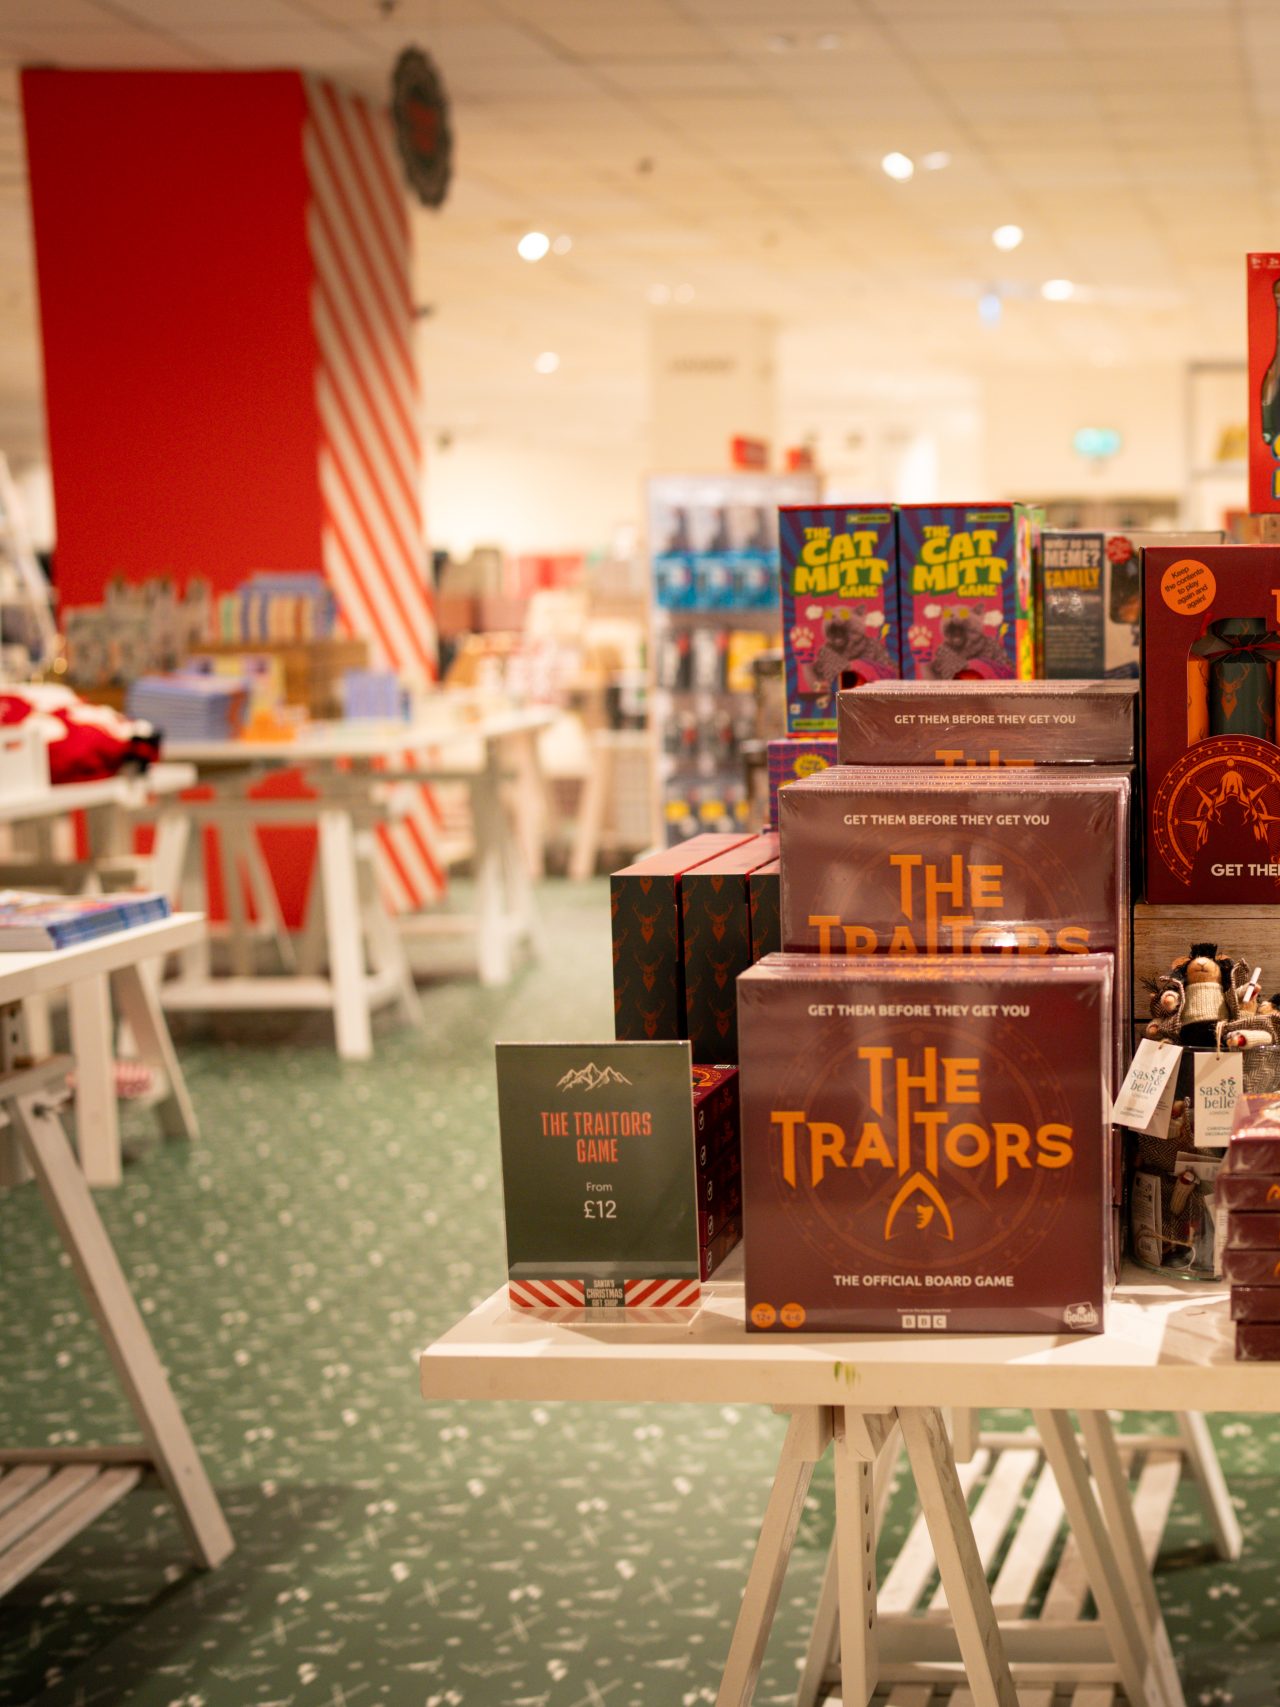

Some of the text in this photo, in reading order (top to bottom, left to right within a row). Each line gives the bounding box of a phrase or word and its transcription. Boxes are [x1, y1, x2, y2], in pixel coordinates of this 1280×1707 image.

[804, 527, 831, 540] THE
[923, 526, 950, 539] THE
[802, 530, 878, 566] CAT
[921, 529, 997, 565] CAT
[1044, 549, 1100, 568] MEME?
[794, 557, 889, 593] MITT
[913, 556, 1008, 592] MITT
[1044, 567, 1100, 591] FAMILY
[838, 585, 878, 598] GAME
[957, 584, 997, 597] GAME
[894, 715, 1076, 725] GET THEM BEFORE THEY GET YOU
[843, 814, 1050, 826] GET THEM BEFORE THEY GET YOU
[1210, 863, 1243, 877] GET
[890, 854, 1004, 920] THE
[808, 1005, 1030, 1017] GET THEM BEFORE THEY GET YOU
[857, 1046, 981, 1118] THE
[1129, 1080, 1158, 1095] belle
[1204, 1097, 1235, 1110] belle
[540, 1111, 653, 1137] THE TRAITORS
[576, 1138, 619, 1163] GAME
[770, 1110, 1075, 1190] TRAITORS
[585, 1182, 613, 1193] From
[583, 1200, 617, 1219] £12
[833, 1275, 1014, 1287] THE OFFICIAL BOARD GAME
[586, 1288, 623, 1299] CHRISTMAS
[901, 1314, 947, 1329] BBC
